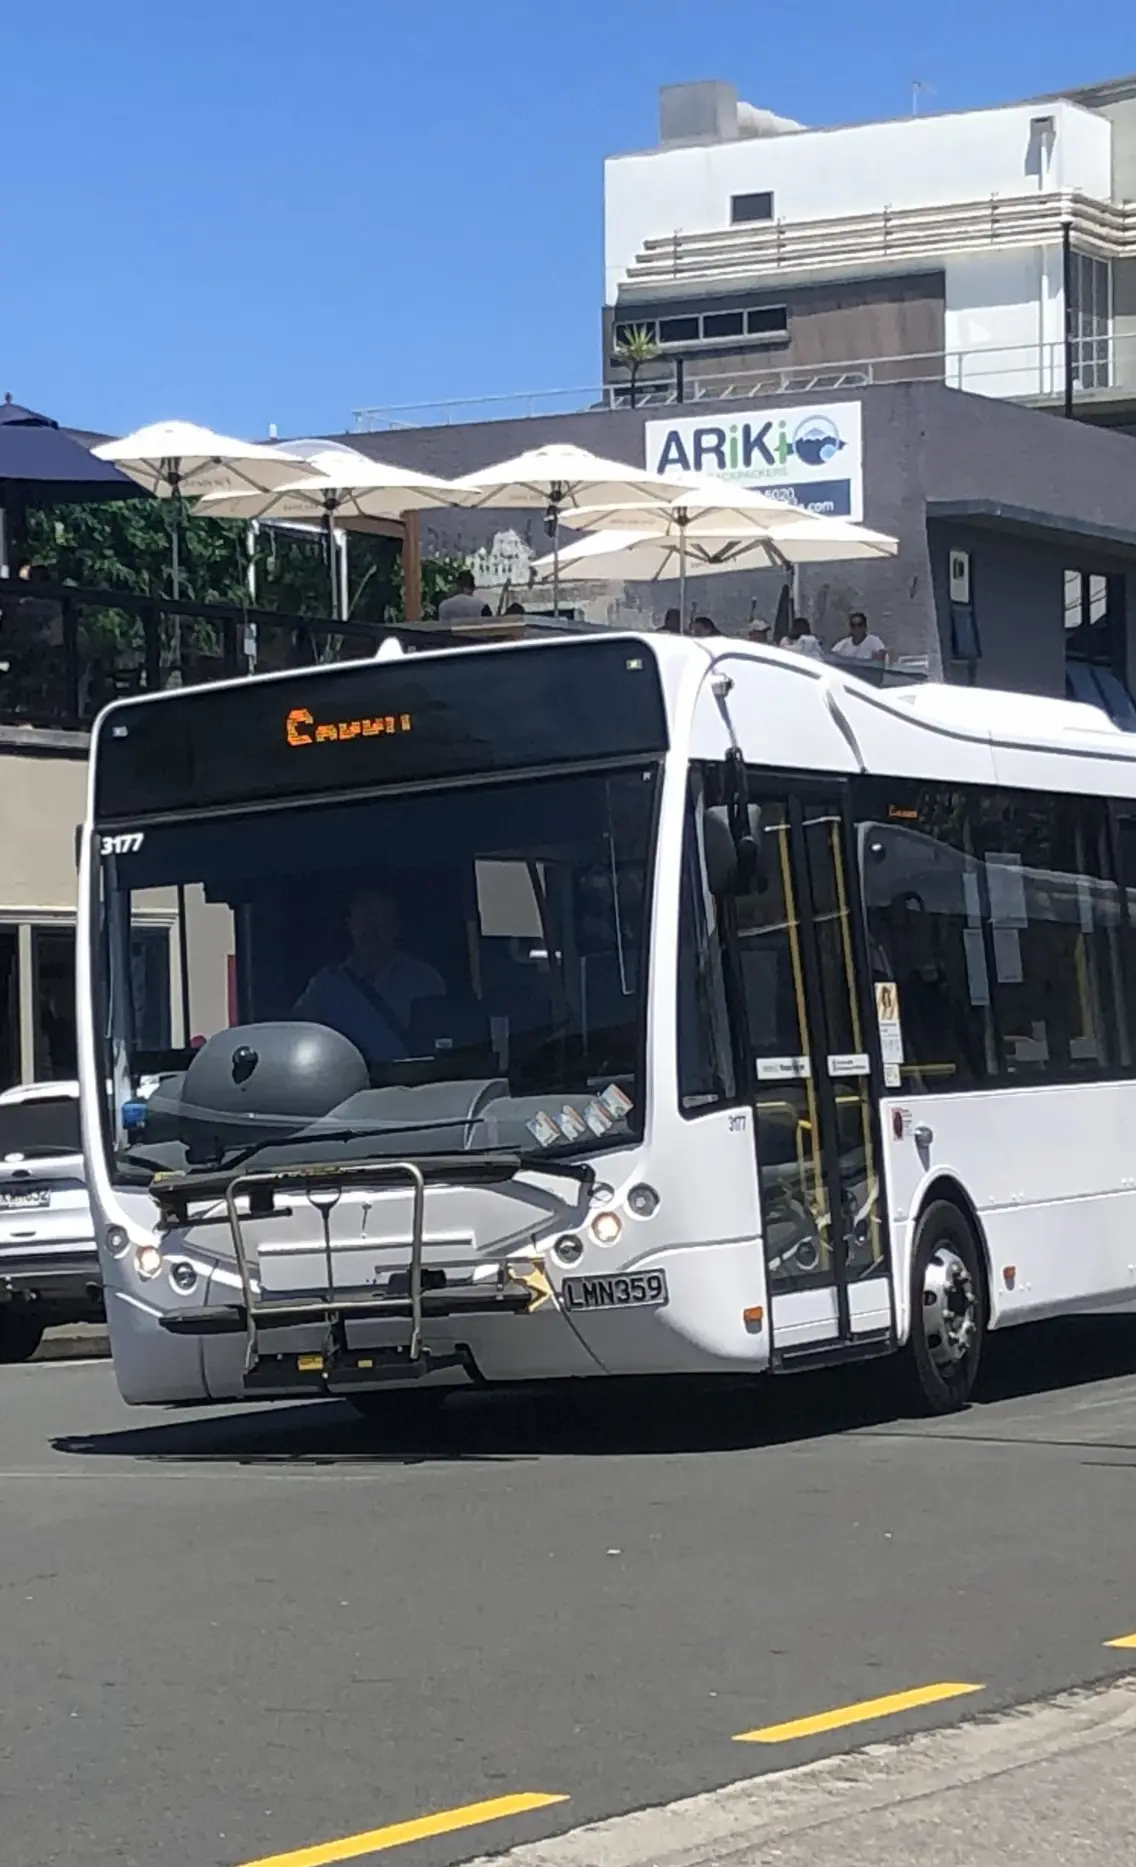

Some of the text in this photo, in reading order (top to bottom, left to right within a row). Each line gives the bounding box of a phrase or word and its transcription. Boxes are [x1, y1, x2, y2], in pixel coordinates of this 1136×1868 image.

[706, 466, 789, 481] ACKPACKERS
[101, 832, 144, 855] 3177
[567, 1274, 662, 1307] LMN359
